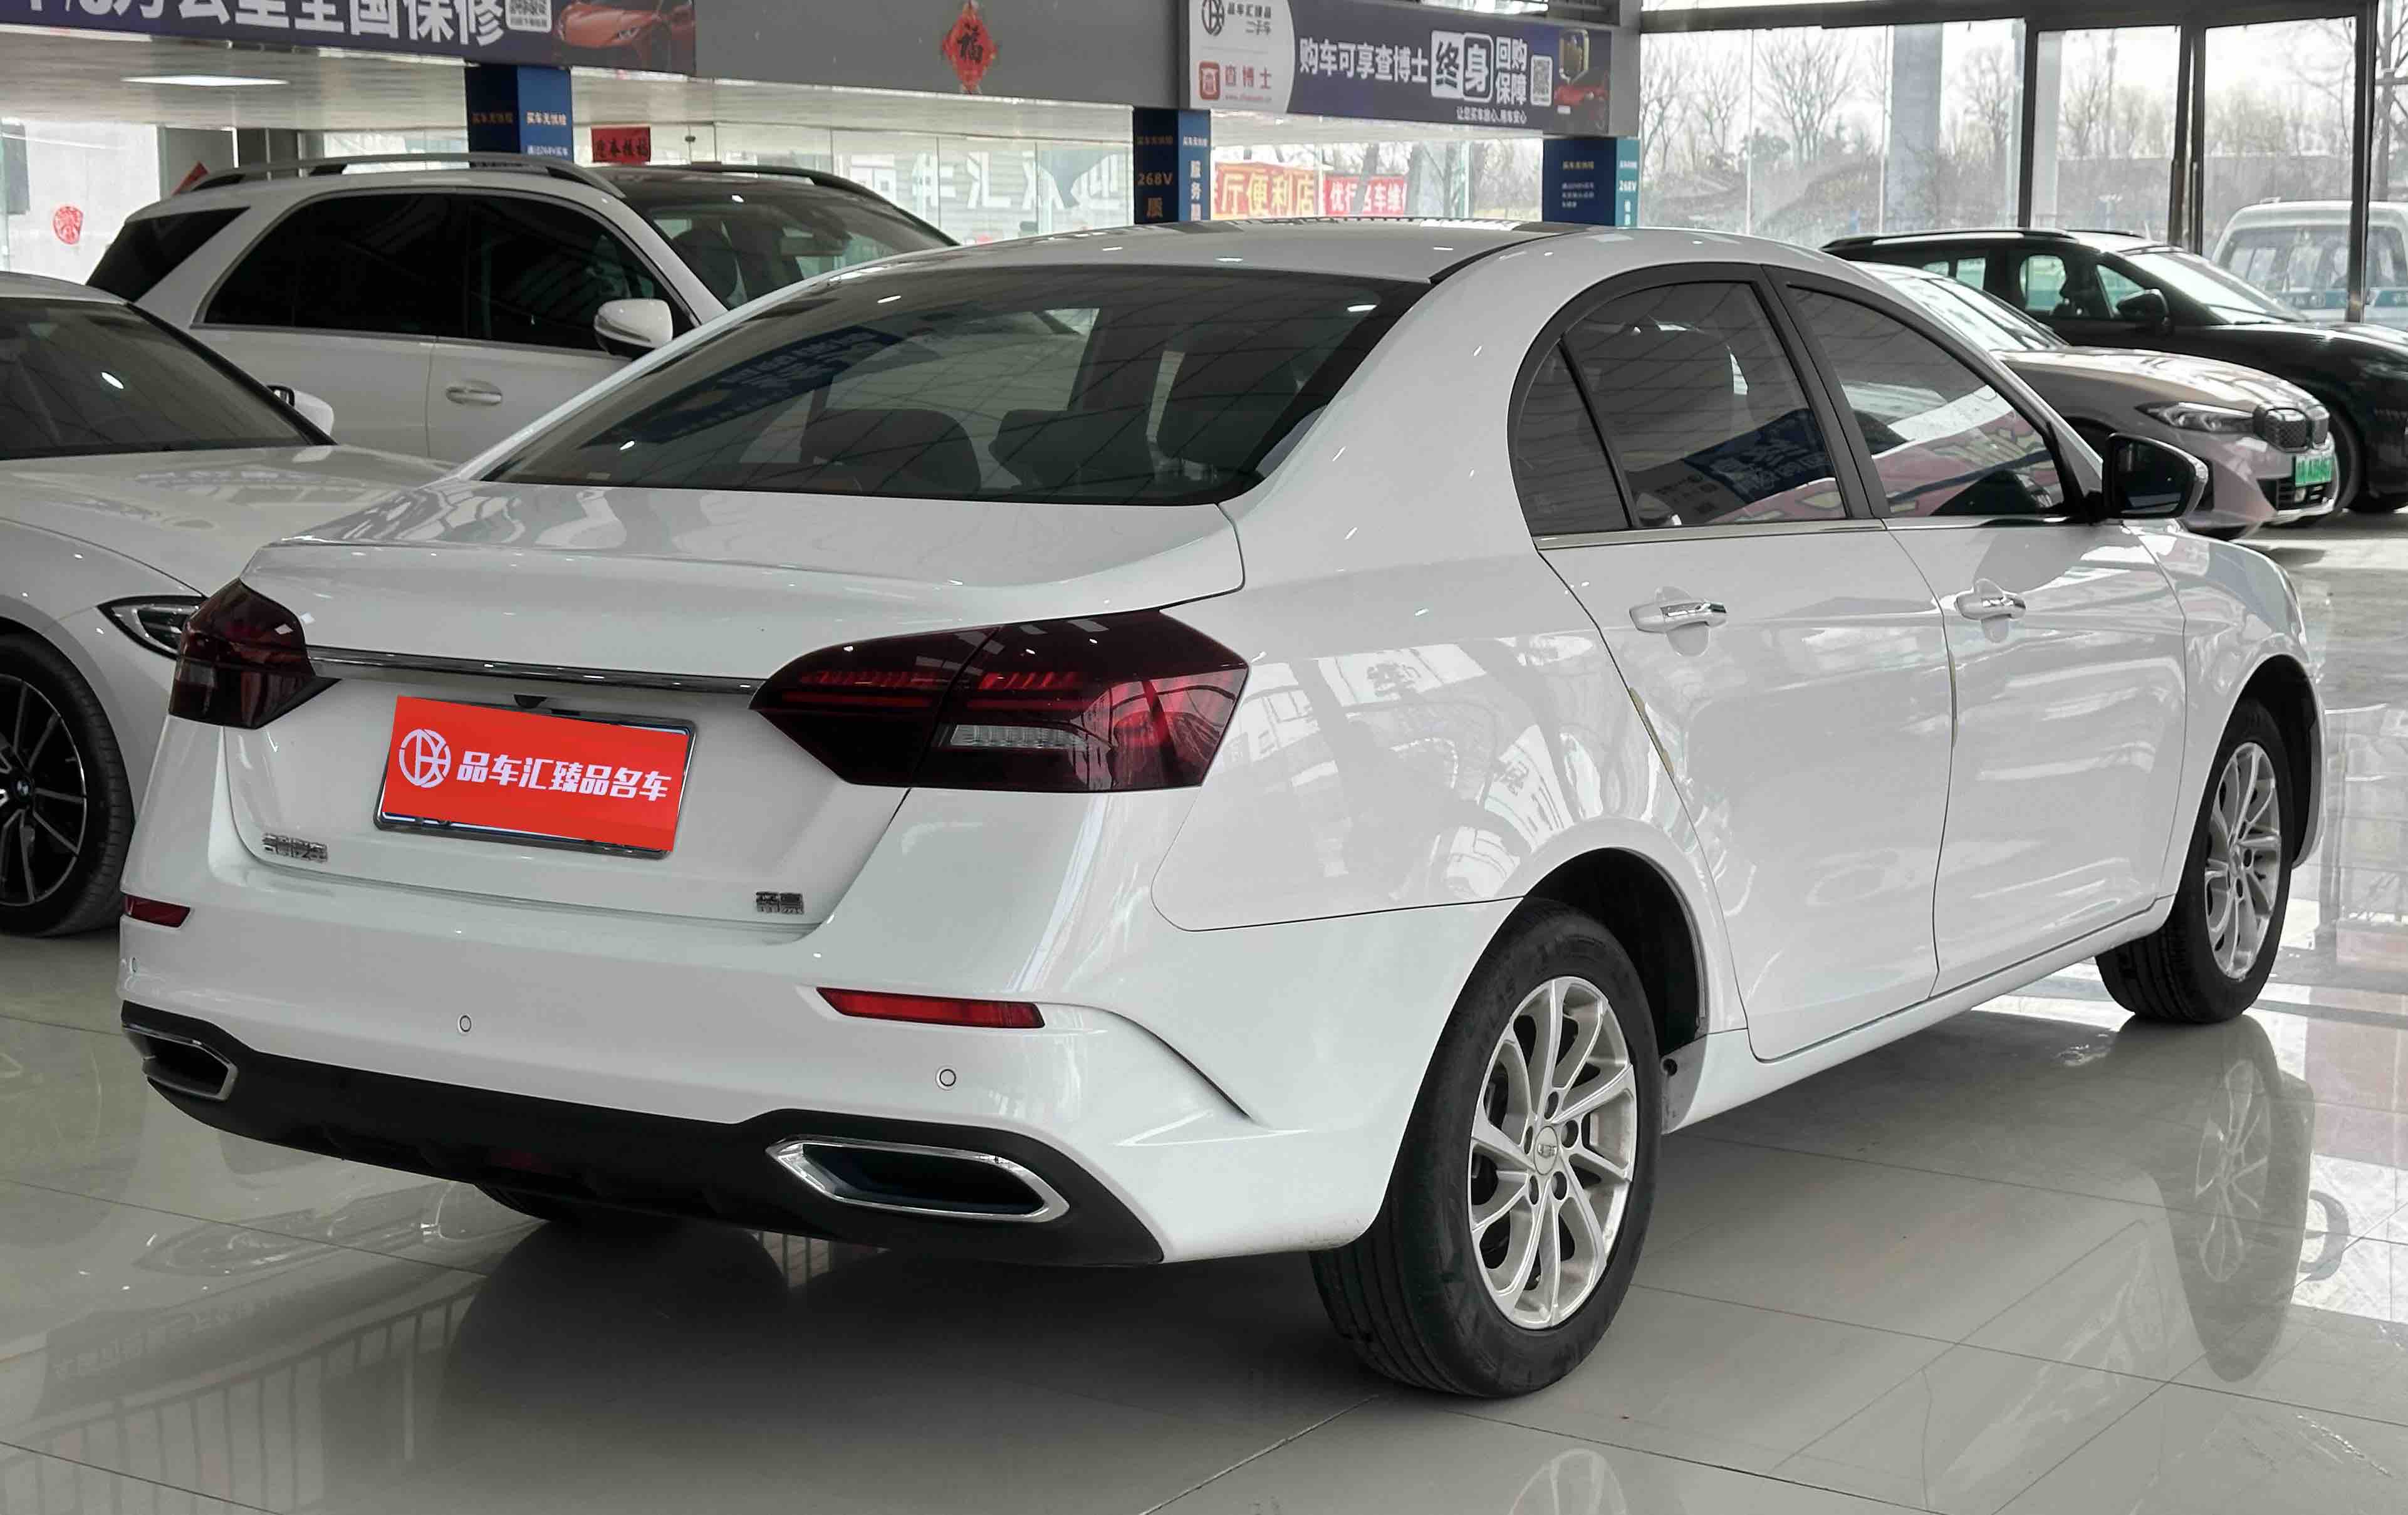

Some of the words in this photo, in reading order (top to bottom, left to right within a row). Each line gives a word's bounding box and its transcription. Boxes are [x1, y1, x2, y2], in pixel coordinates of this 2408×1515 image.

[1300, 37, 1429, 83] 购车可享查博士
[1434, 39, 1489, 94] 终身
[1495, 36, 1528, 72] 回购
[1225, 65, 1272, 90] 查博士
[1495, 72, 1528, 105] 保障
[1137, 172, 1174, 186] 268V
[1212, 169, 1315, 217] 厅便利店
